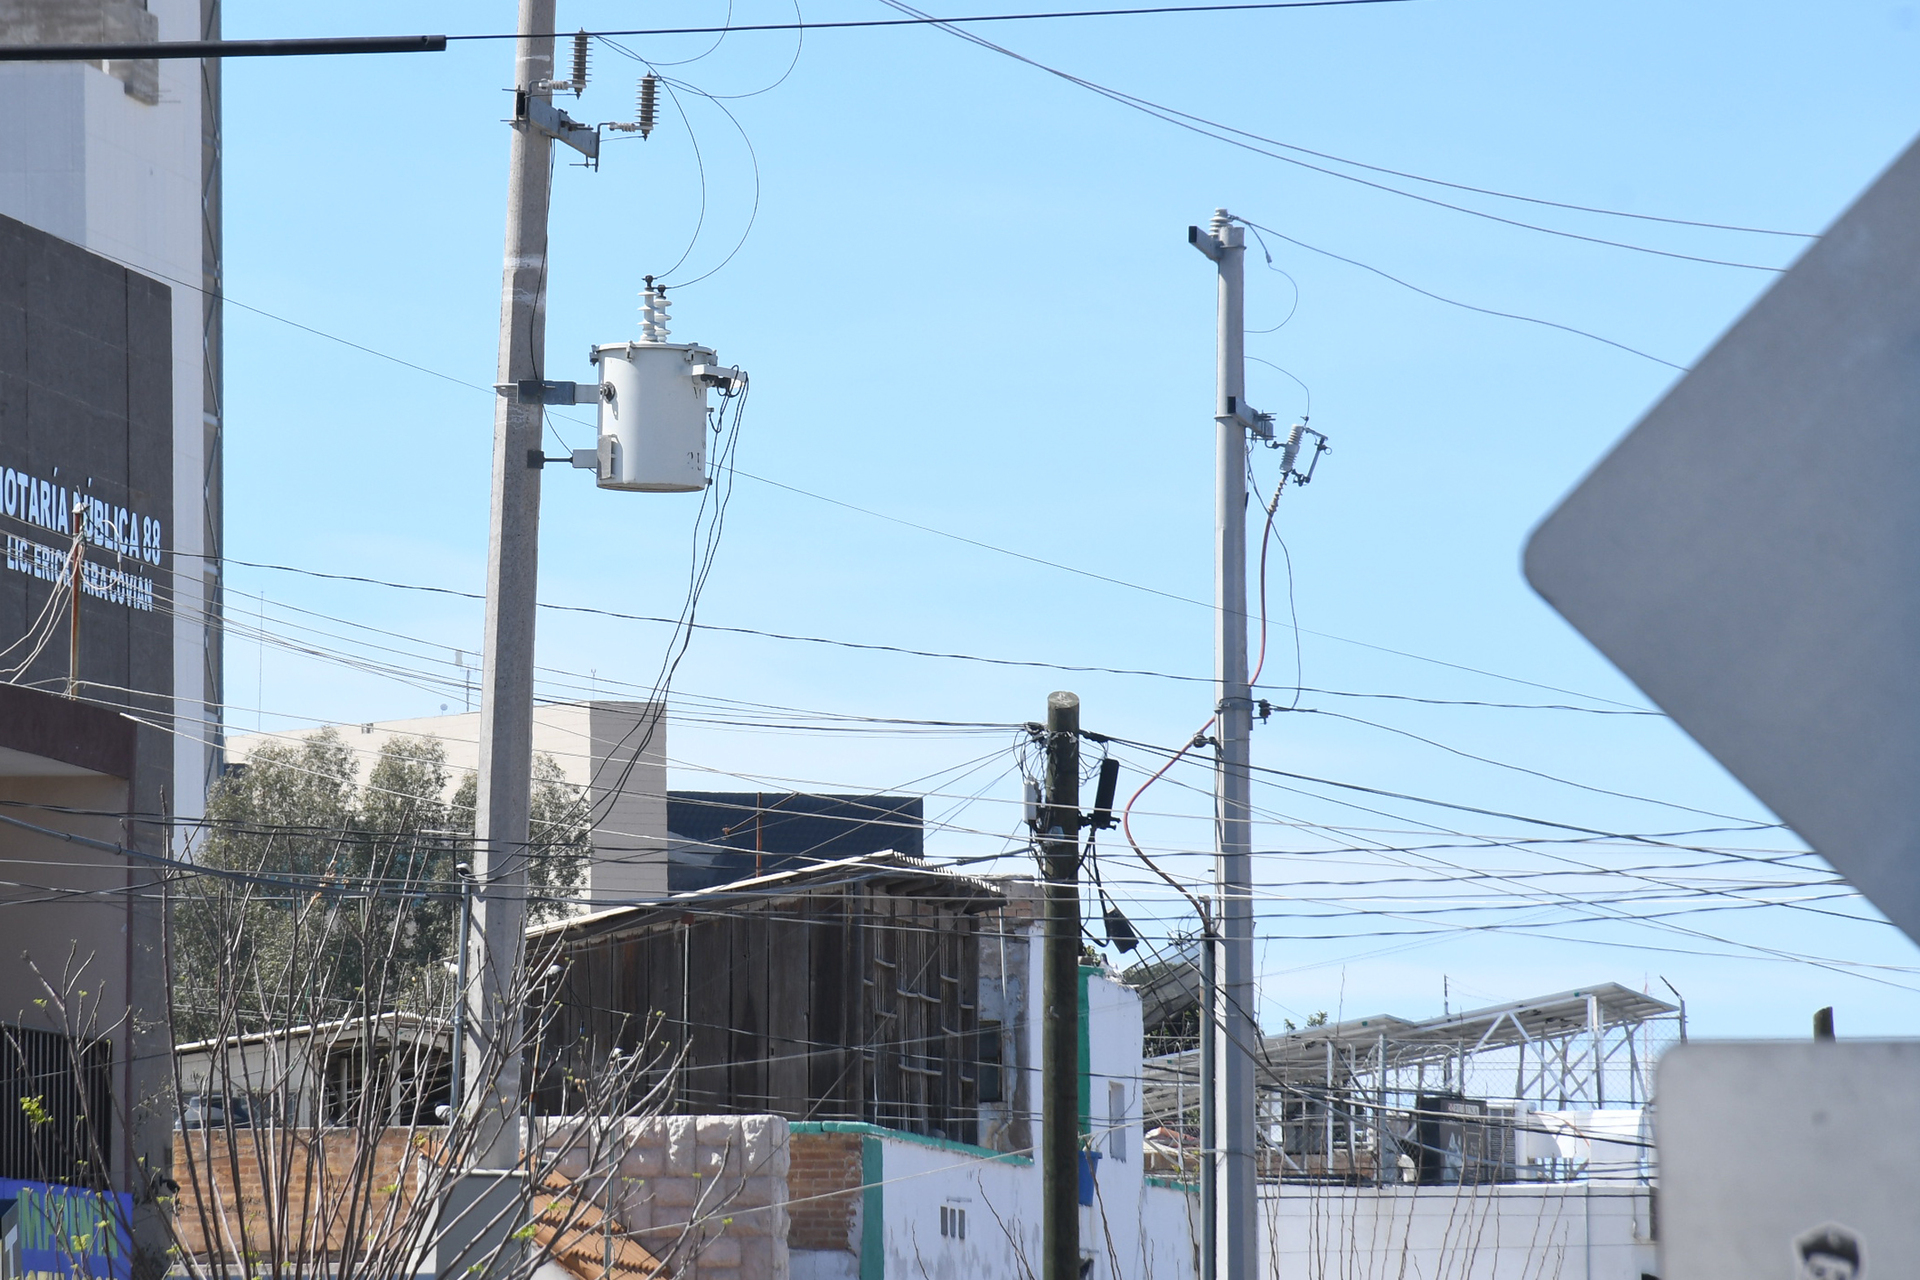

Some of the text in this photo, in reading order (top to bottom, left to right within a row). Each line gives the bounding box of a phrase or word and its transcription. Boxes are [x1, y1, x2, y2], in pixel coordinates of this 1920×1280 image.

[143, 515, 161, 566] 88
[7, 534, 31, 575] LIC.
[79, 559, 108, 600] ARA
[110, 565, 153, 612] COVIÁN
